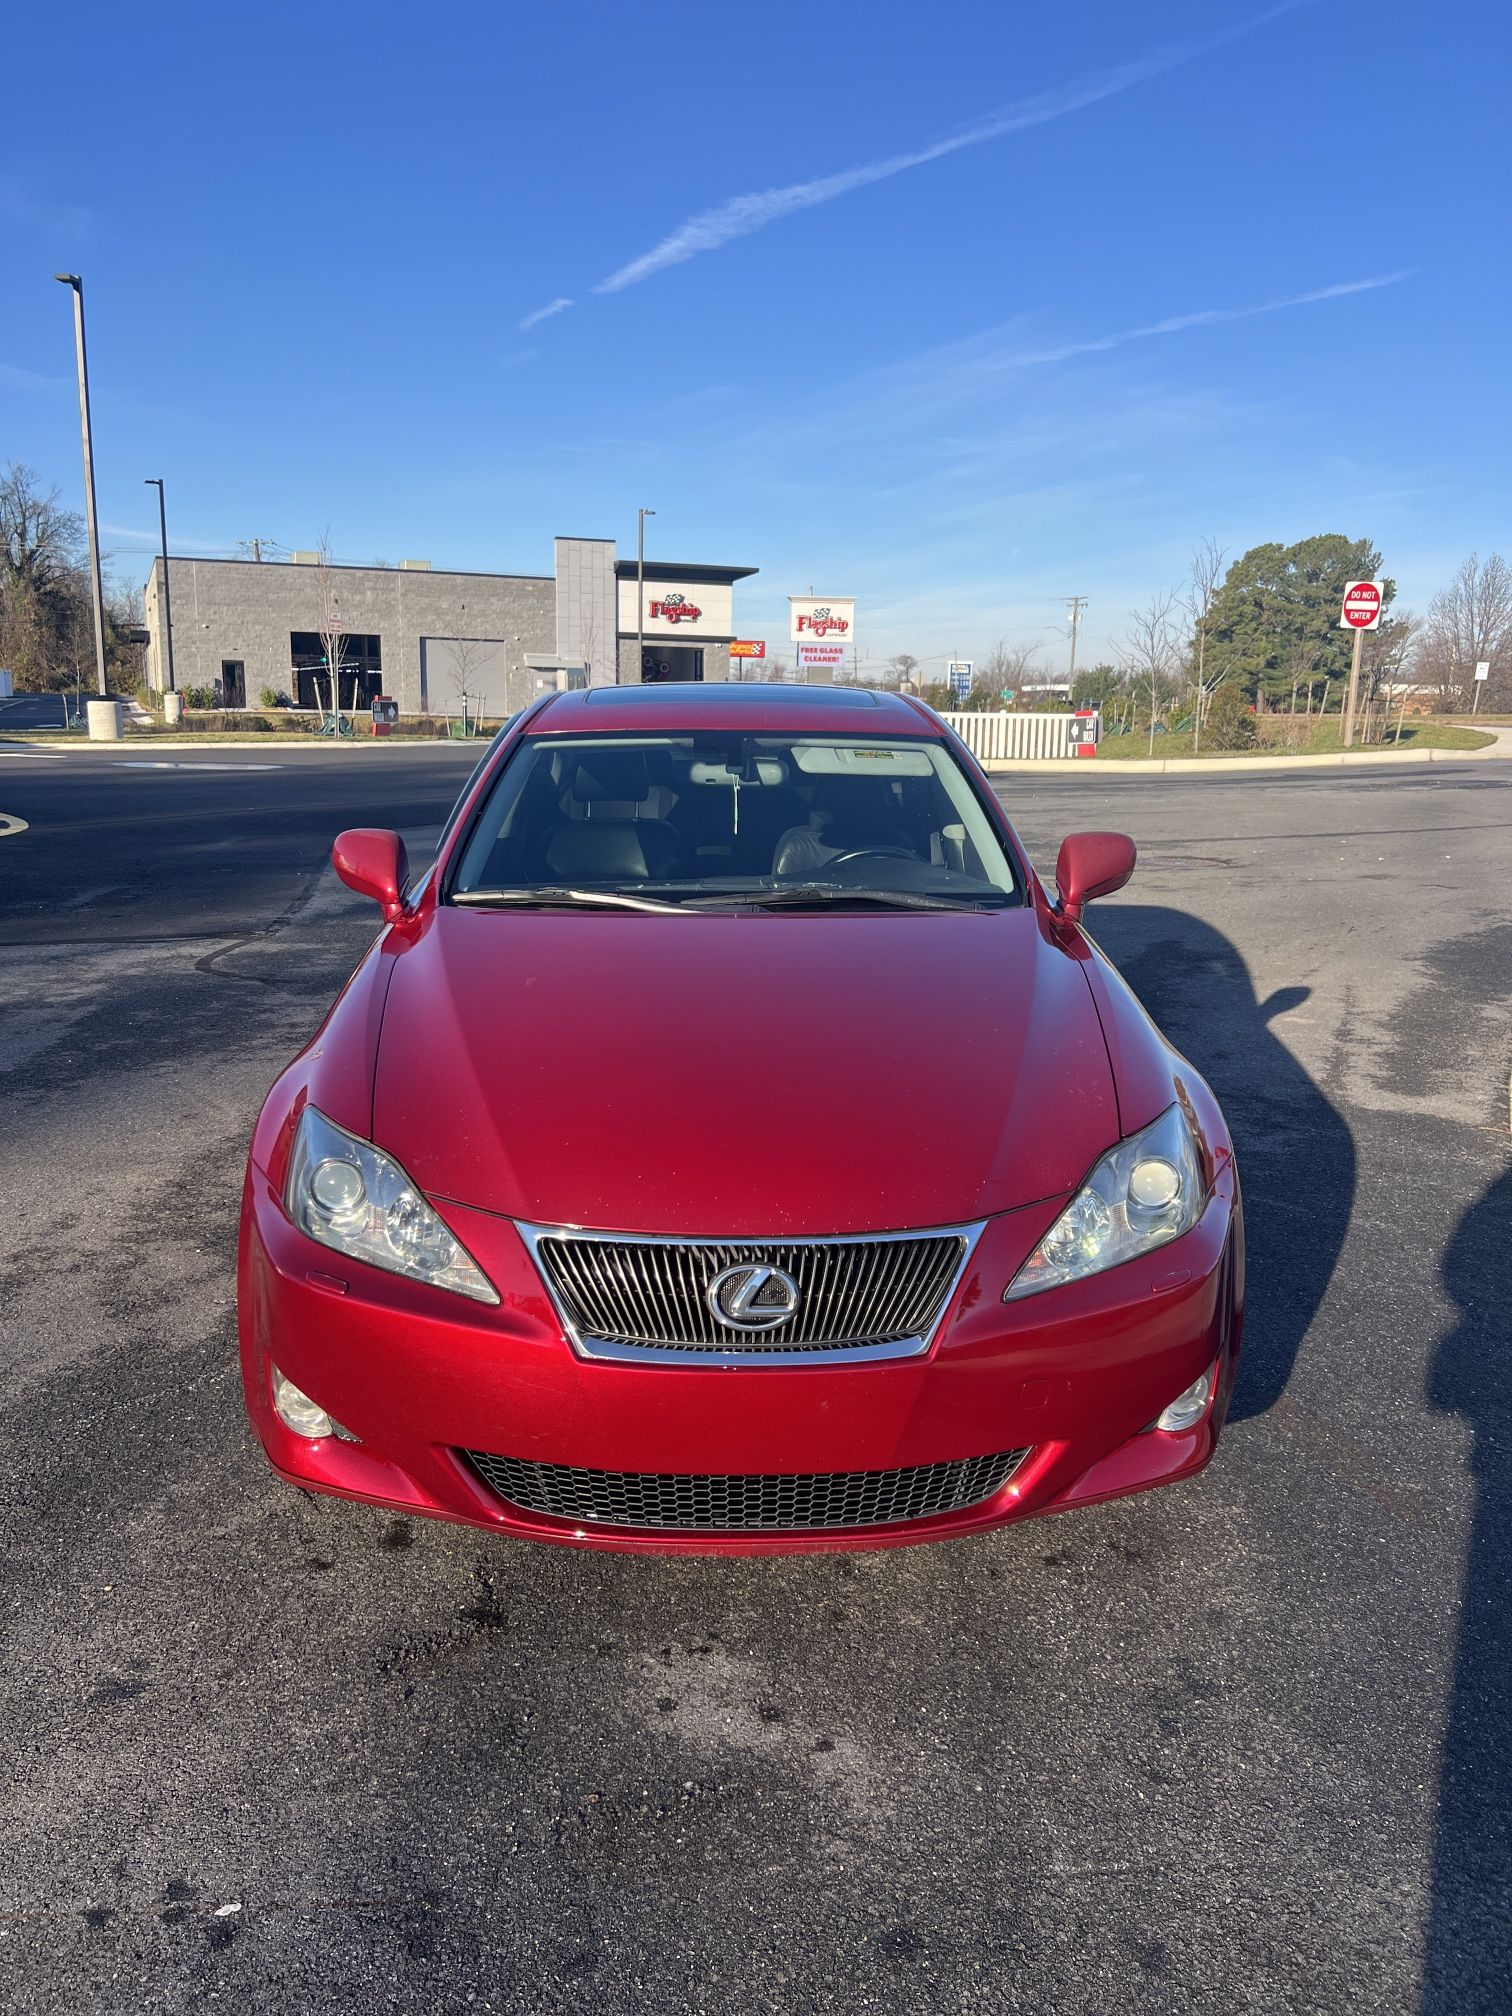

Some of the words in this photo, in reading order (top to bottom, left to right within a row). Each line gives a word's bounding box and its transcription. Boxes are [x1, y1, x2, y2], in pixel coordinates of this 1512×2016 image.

[1351, 591, 1360, 599] DO
[1362, 591, 1376, 600] NOT
[649, 600, 702, 624] Flagship
[1350, 611, 1371, 620] ENTER
[796, 614, 849, 637] Flagship
